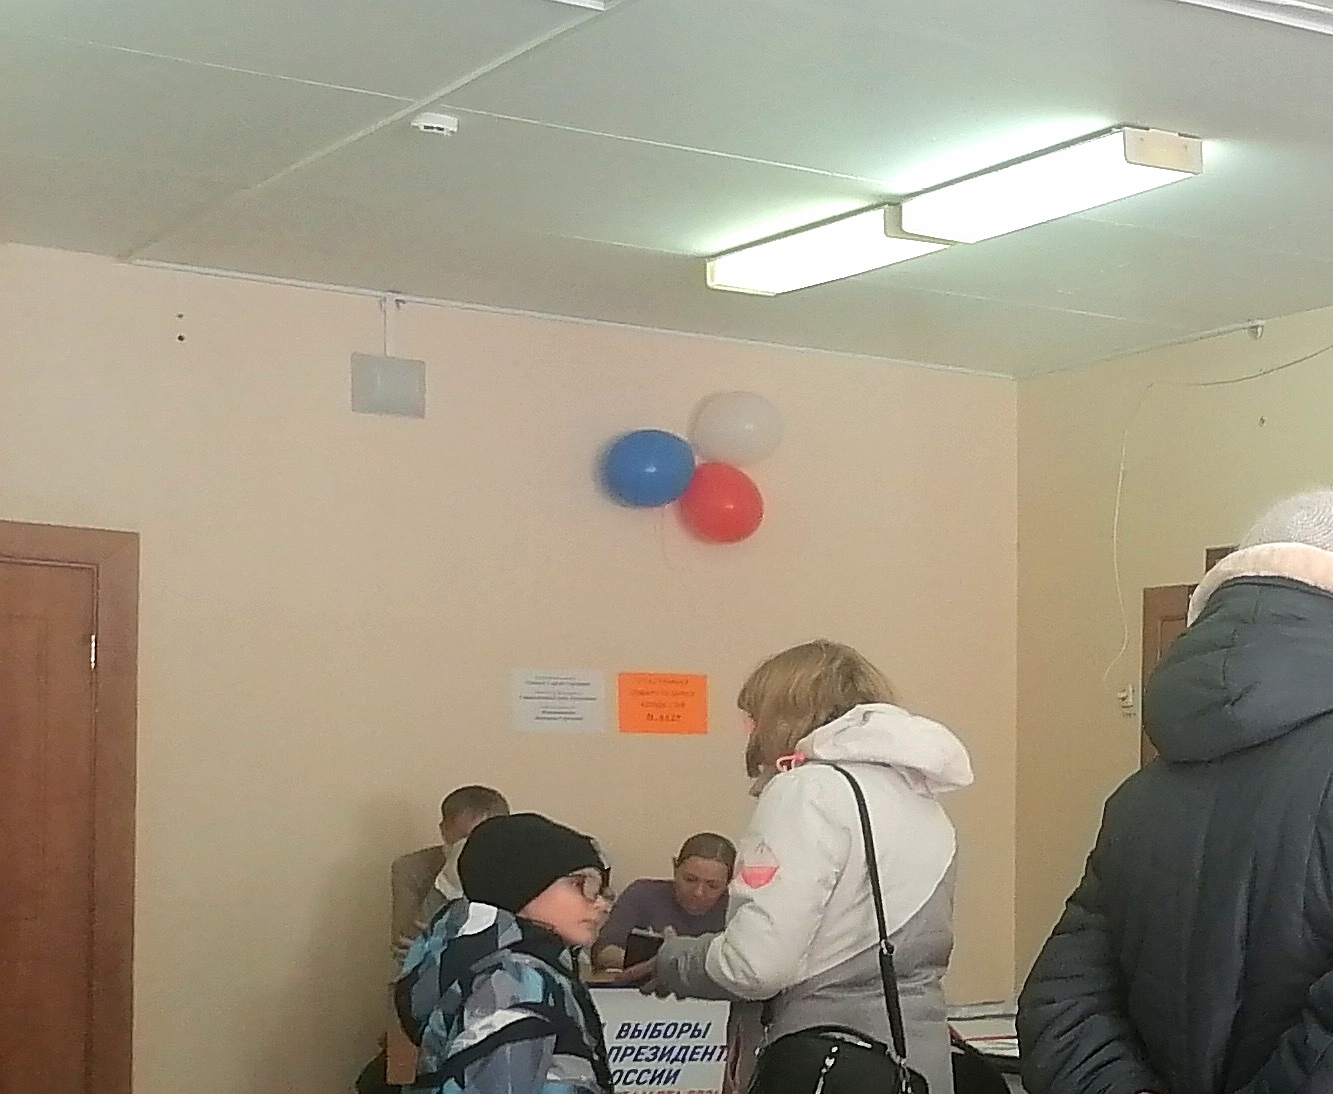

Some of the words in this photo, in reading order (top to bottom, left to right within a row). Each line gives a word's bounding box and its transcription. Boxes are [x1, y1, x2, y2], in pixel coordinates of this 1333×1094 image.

[615, 1021, 712, 1040] ВЫБОРЫ
[608, 1045, 728, 1065] ПРЕЗИДЕНТ
[611, 1068, 681, 1086] ОССИИ
